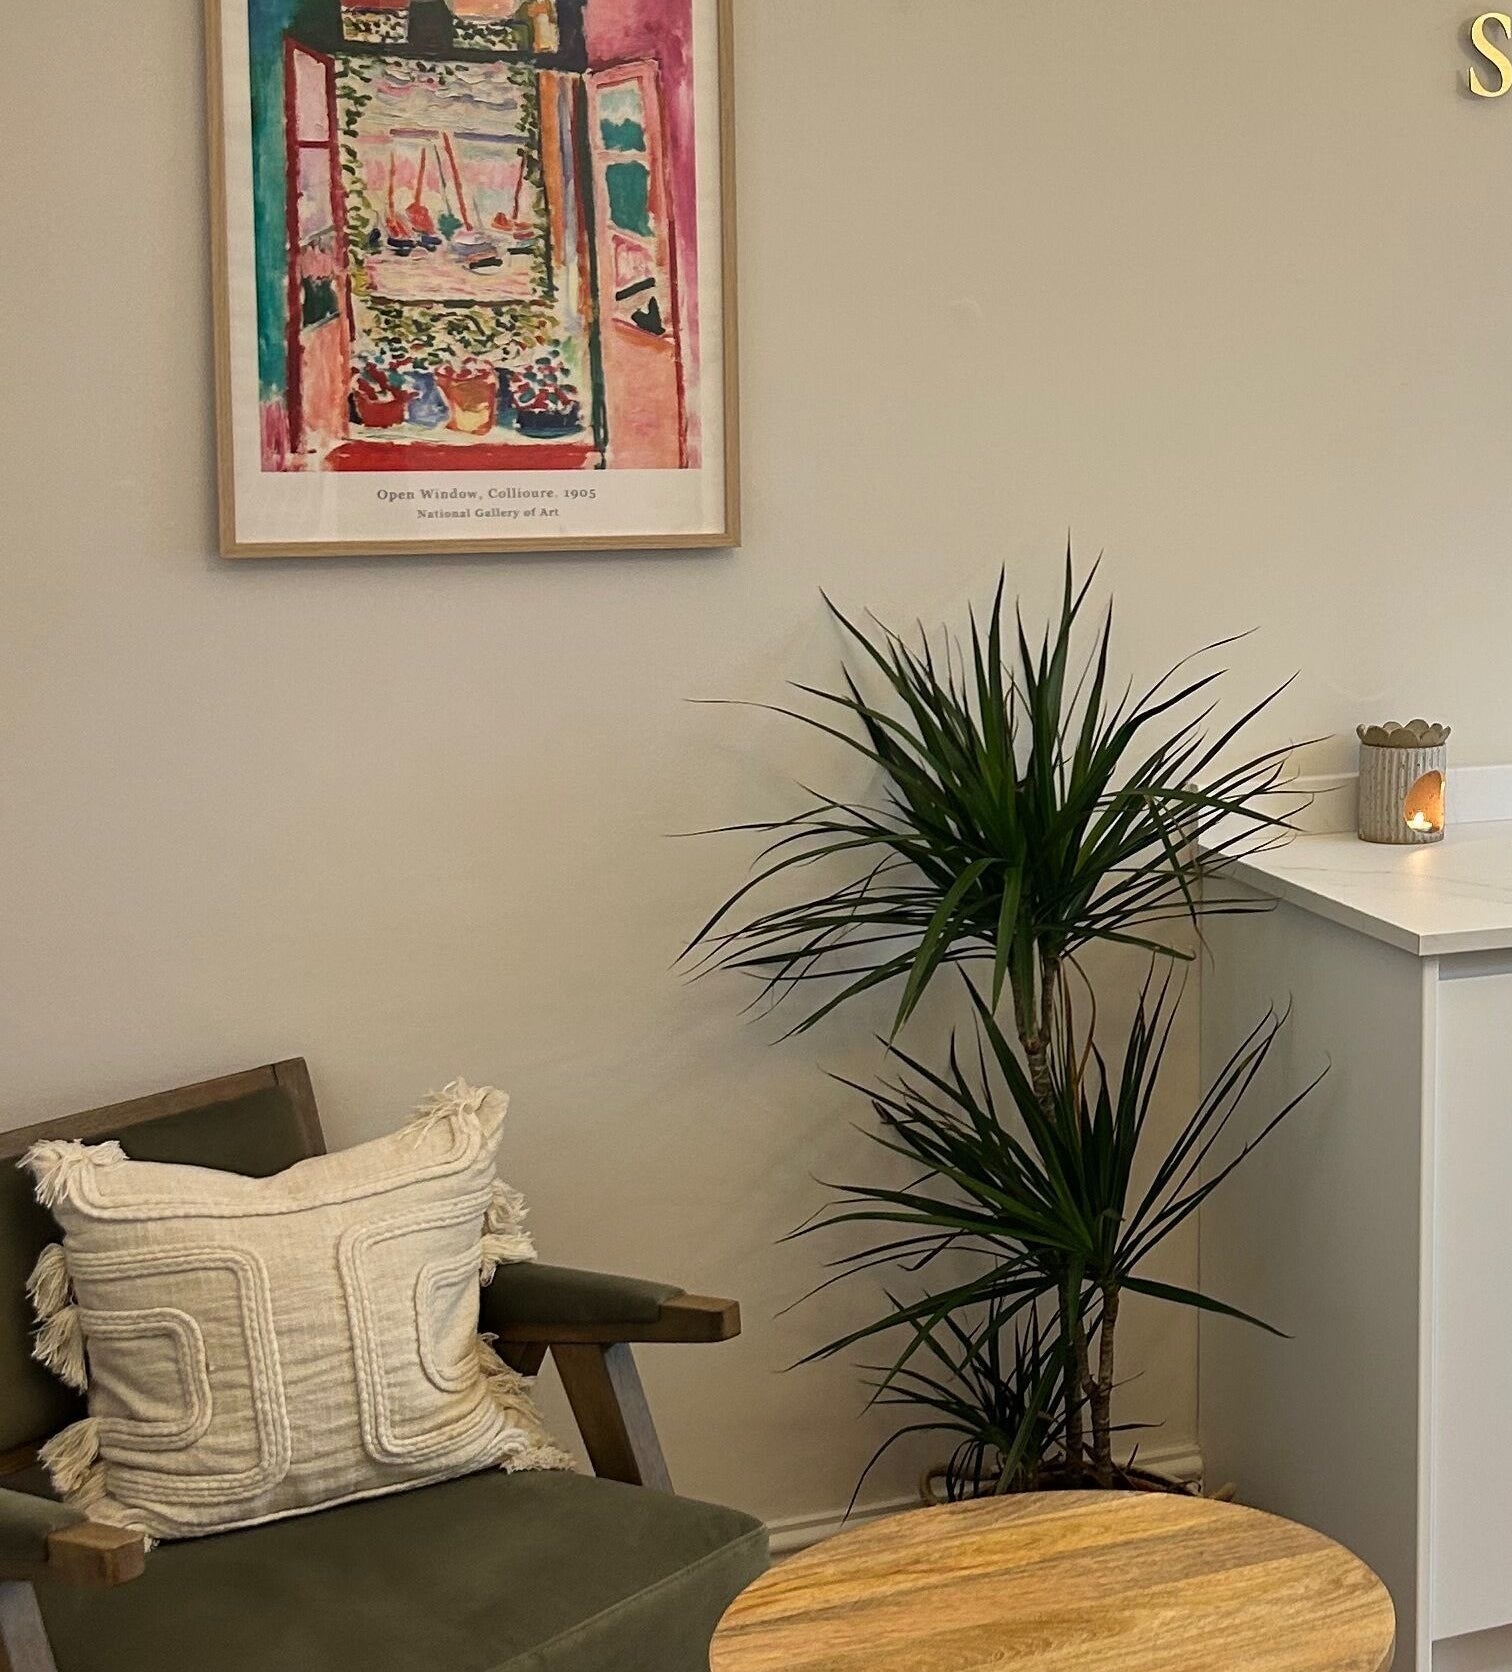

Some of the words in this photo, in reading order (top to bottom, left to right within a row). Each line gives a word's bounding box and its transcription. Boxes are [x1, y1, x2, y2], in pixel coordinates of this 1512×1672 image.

[376, 488, 416, 503] Open
[420, 487, 483, 501] Window,
[563, 488, 597, 500] 1905
[416, 508, 471, 519] National
[474, 507, 520, 520] Gallery
[523, 506, 536, 518] of
[539, 507, 560, 518] Art
